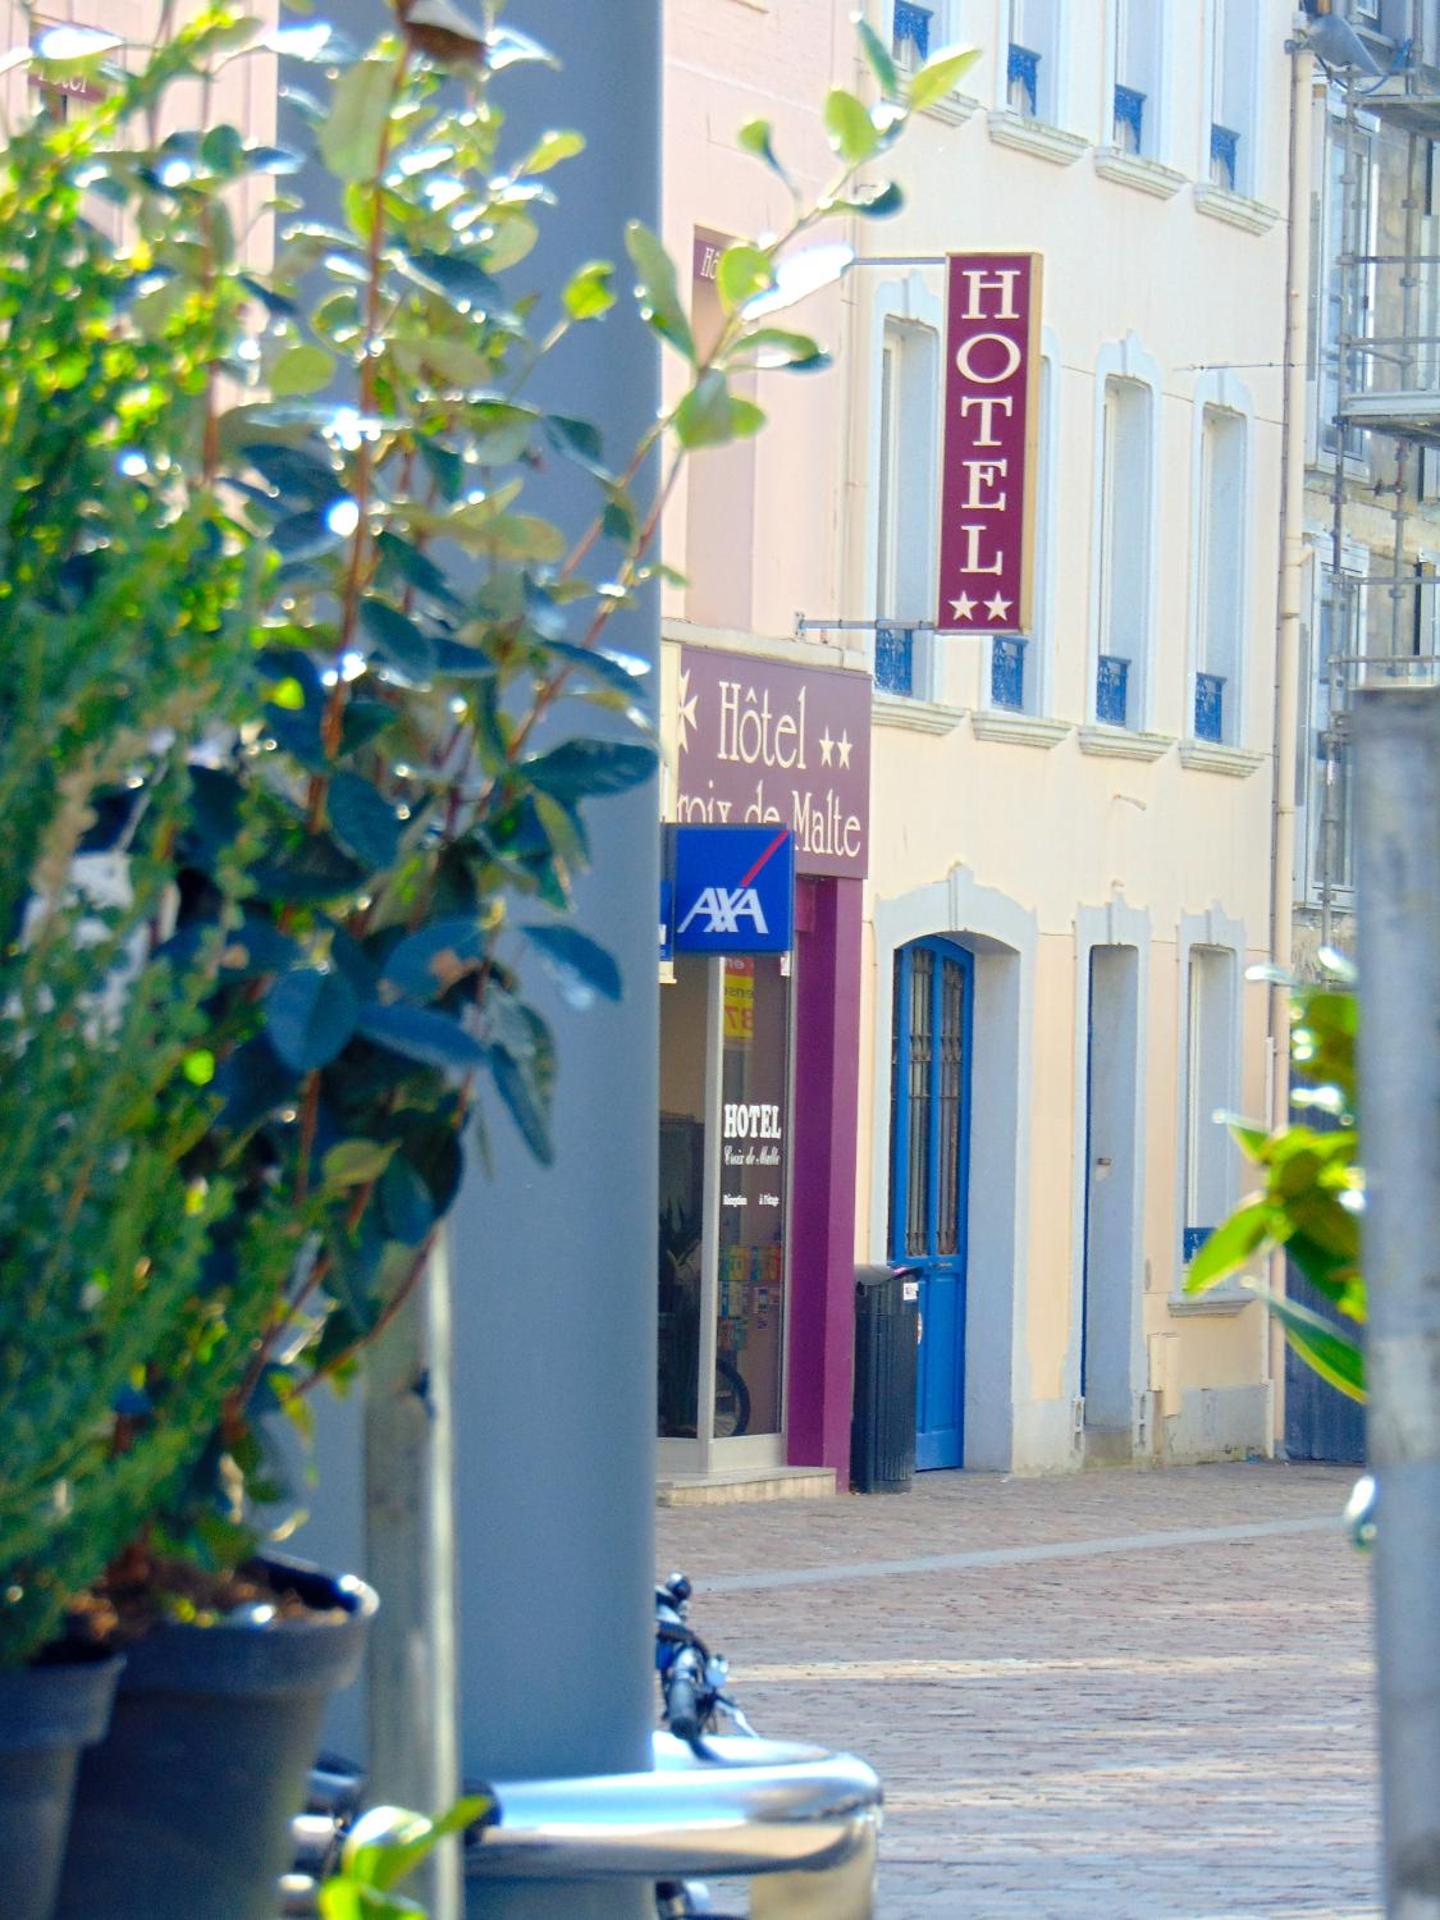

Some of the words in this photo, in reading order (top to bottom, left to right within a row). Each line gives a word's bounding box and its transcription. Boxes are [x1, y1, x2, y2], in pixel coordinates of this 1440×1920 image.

[955, 269, 1022, 577] HOTEL
[716, 680, 807, 770] Hôtel
[676, 779, 733, 824] roix
[791, 788, 861, 858] Malte
[676, 887, 770, 934] AXA
[723, 1103, 782, 1139] HOTEL
